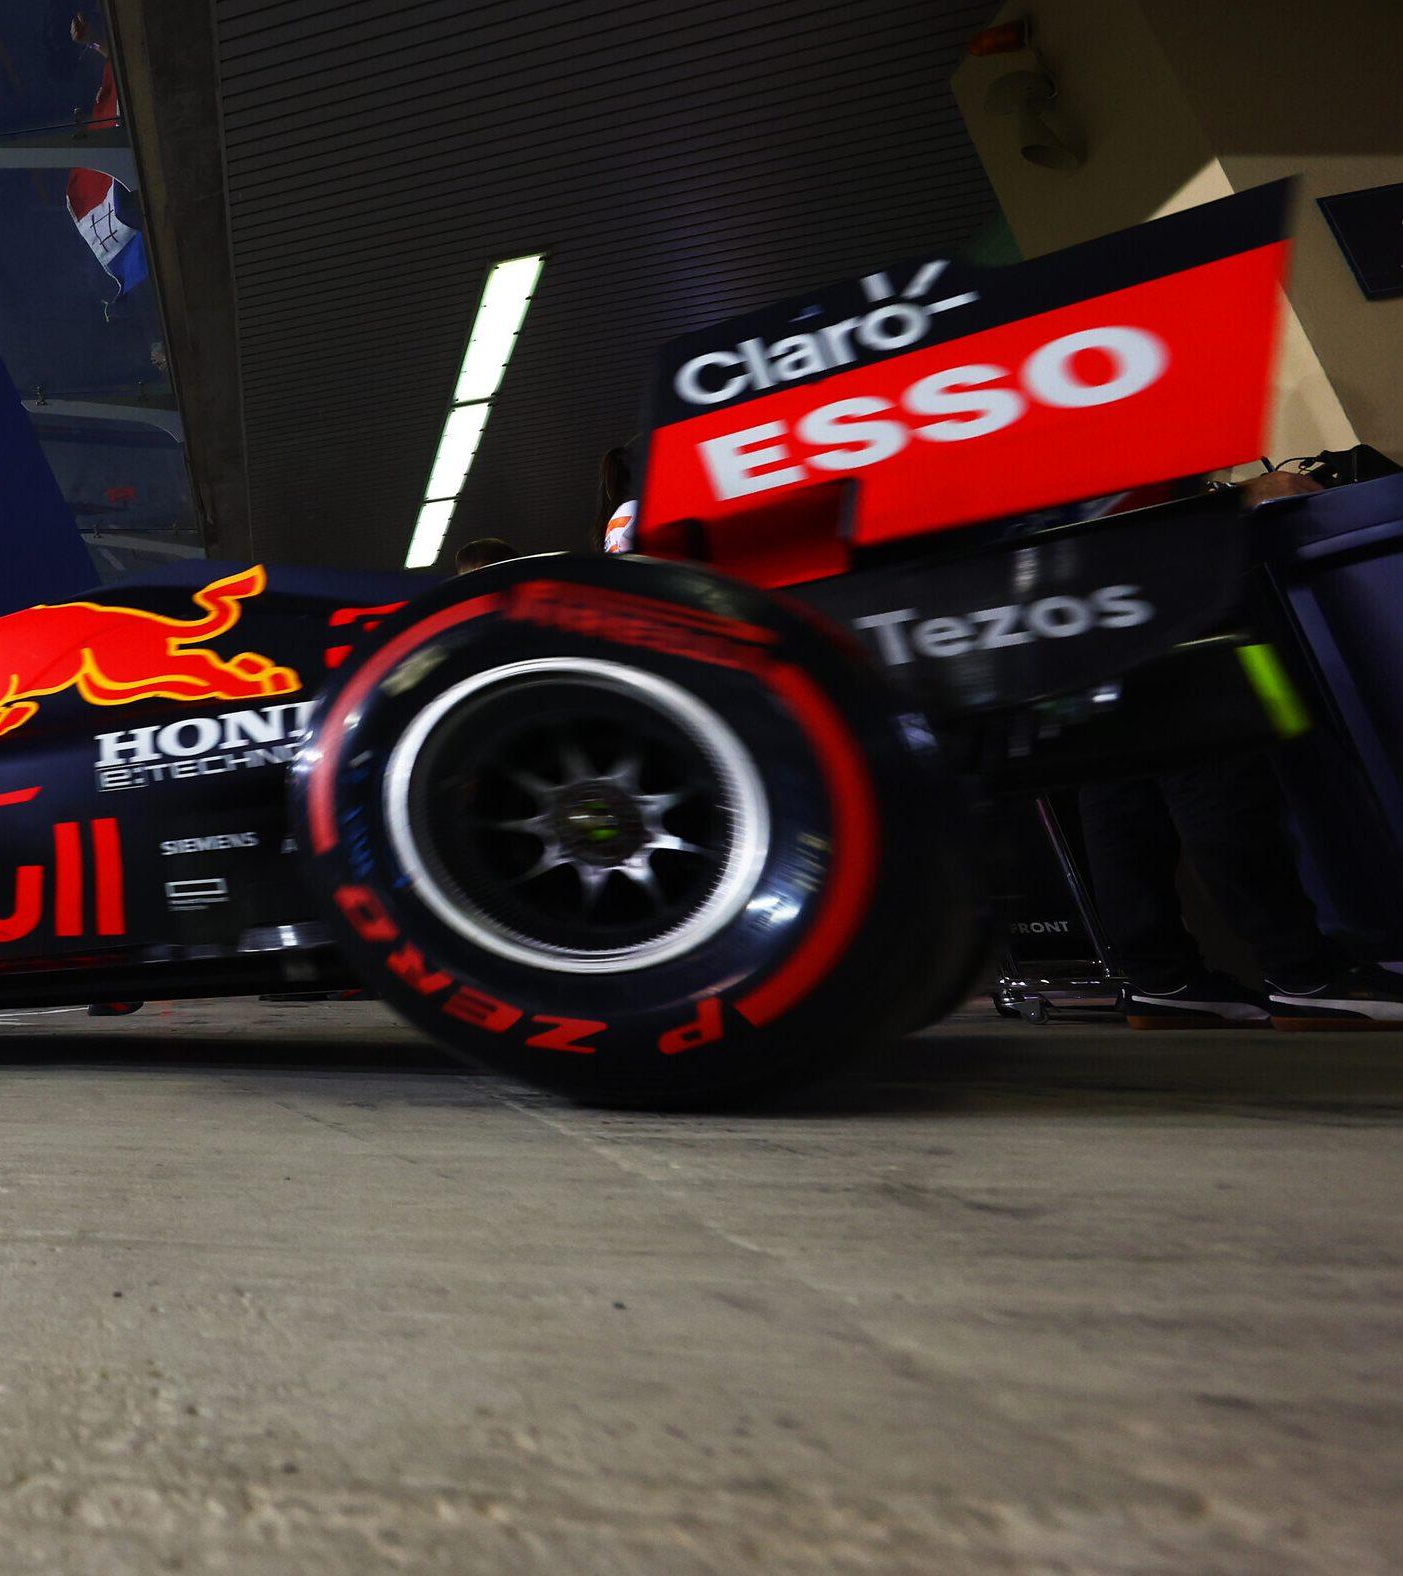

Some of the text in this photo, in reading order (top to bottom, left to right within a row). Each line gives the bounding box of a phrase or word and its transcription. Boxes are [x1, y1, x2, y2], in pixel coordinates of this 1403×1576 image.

[675, 293, 934, 406] Claro
[697, 325, 1171, 502] ESSO
[855, 583, 1156, 667] Tezos
[159, 832, 260, 856] SIEMENS
[333, 884, 725, 1055] P ZERO
